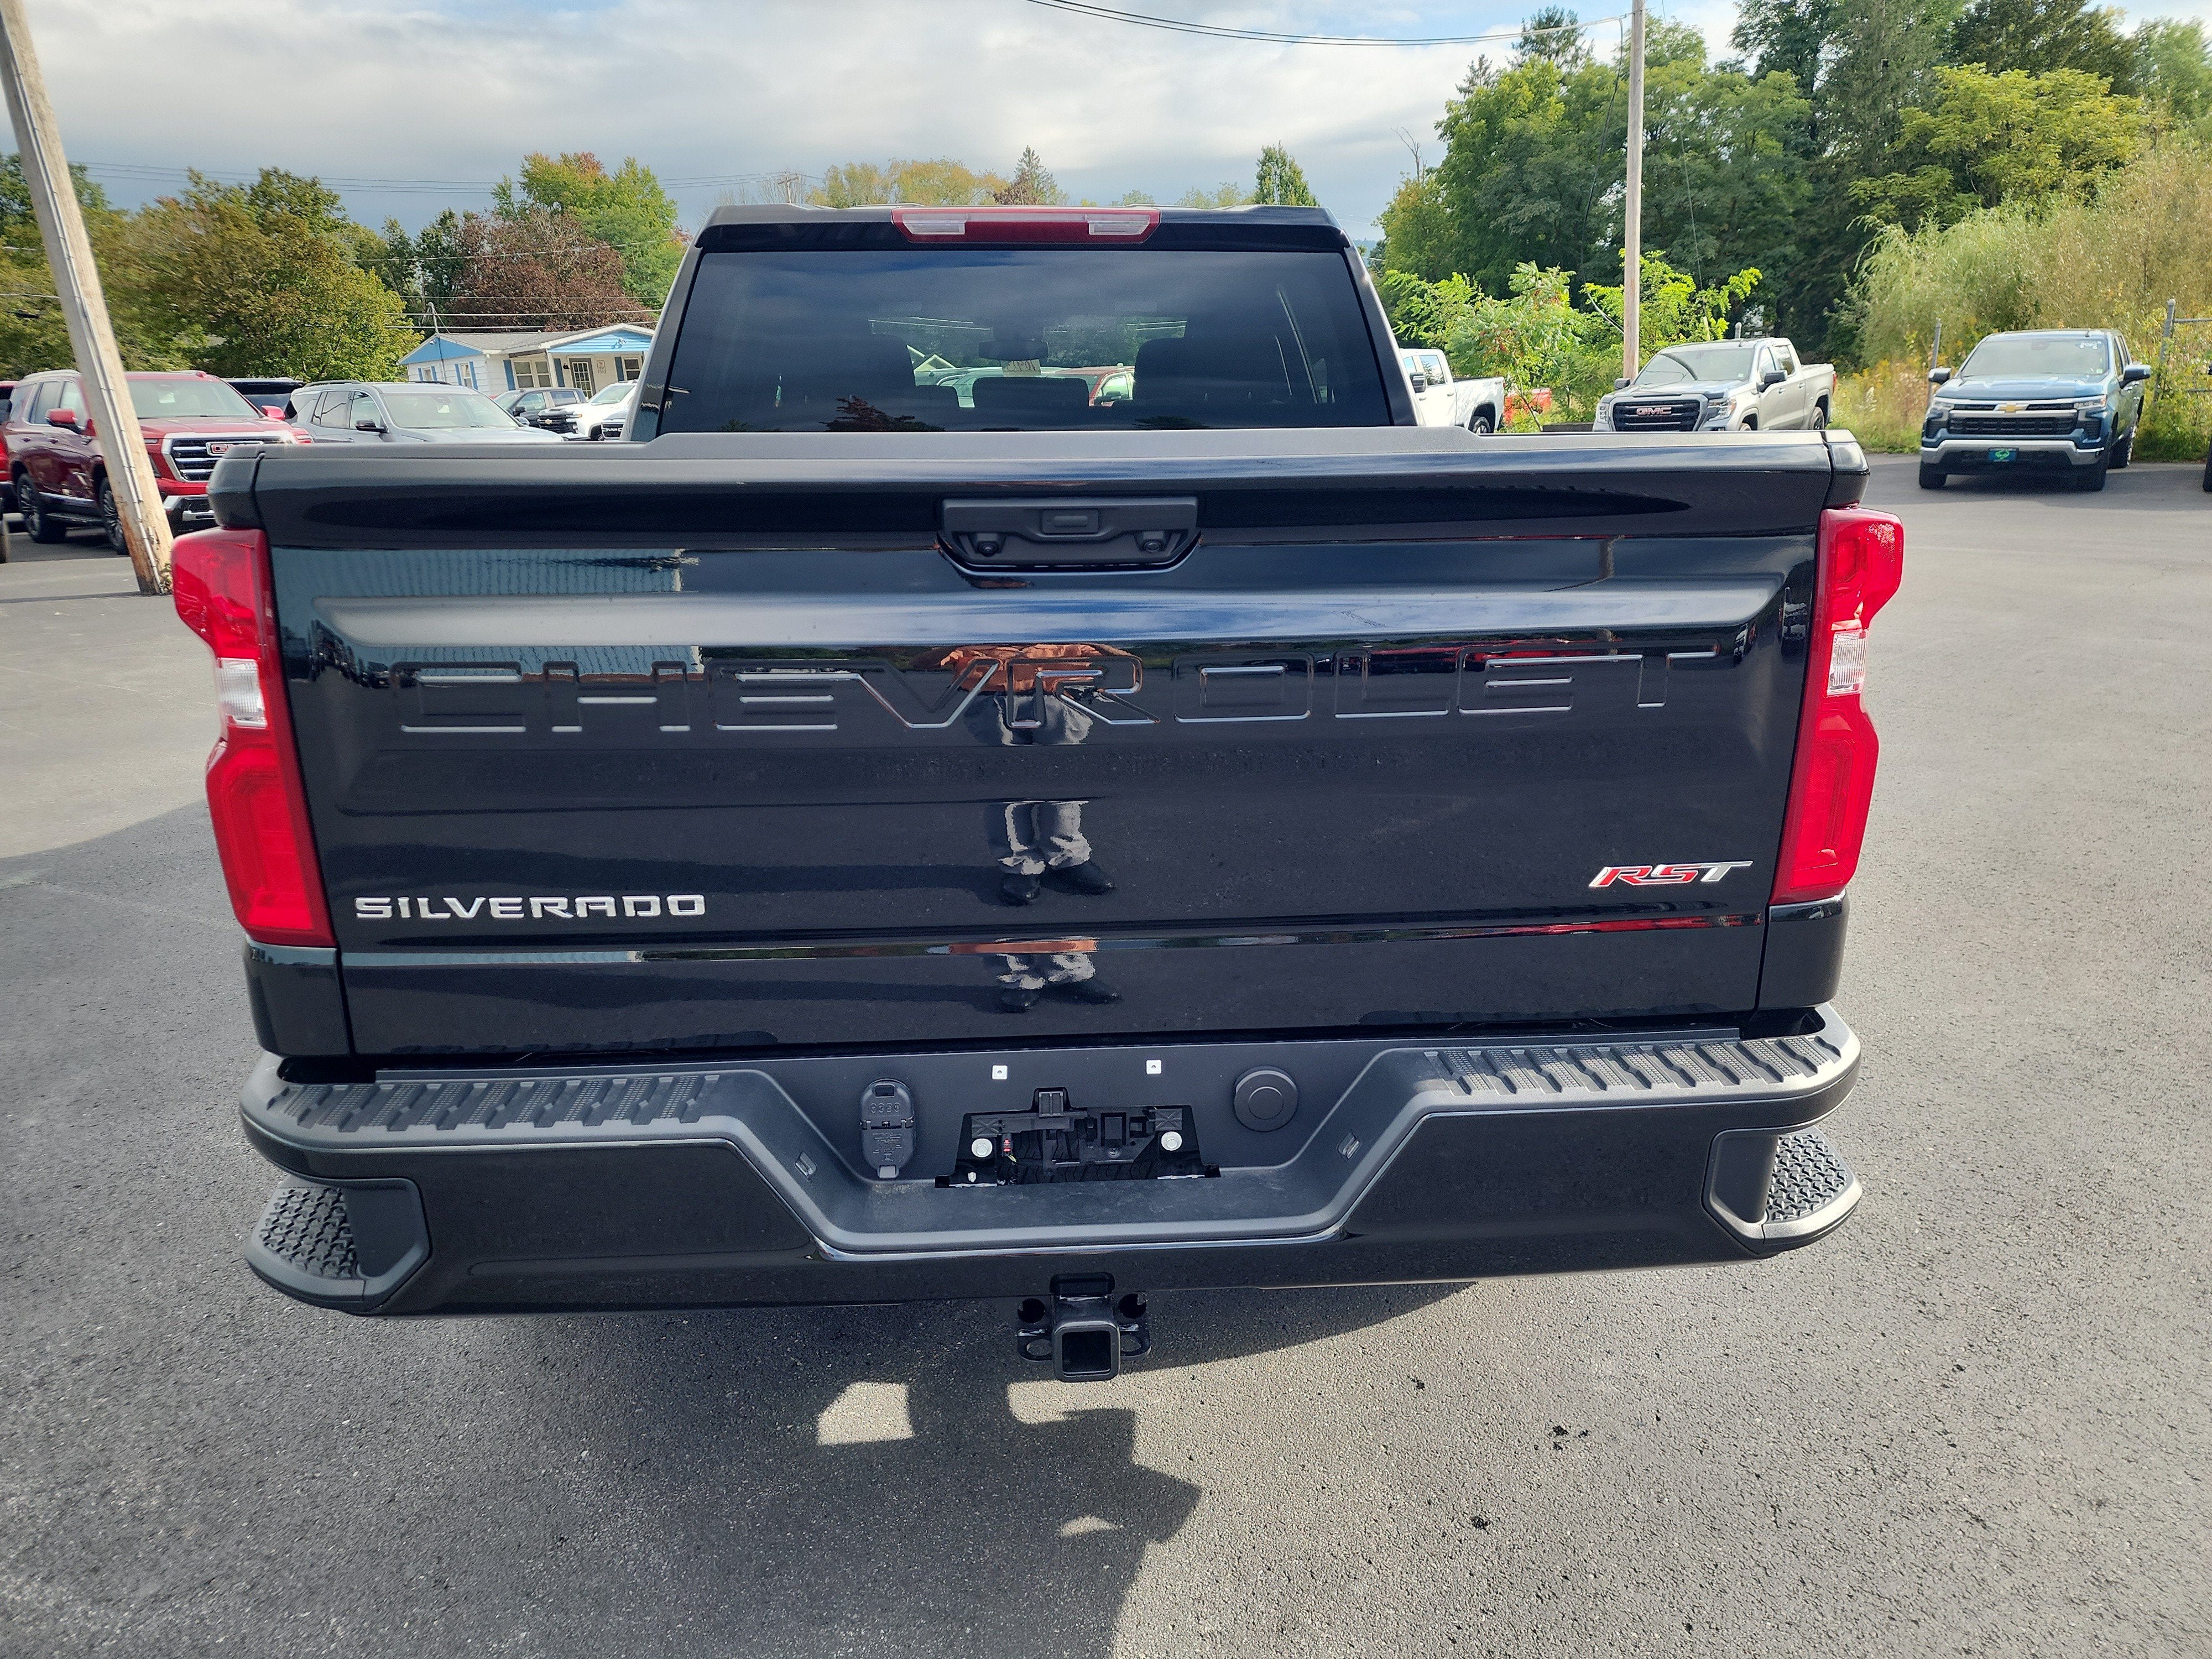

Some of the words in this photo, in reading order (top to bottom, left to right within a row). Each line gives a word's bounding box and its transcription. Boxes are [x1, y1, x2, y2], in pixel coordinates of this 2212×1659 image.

[390, 638, 1721, 733] CHEVROLET
[1589, 860, 1753, 887] RST
[354, 894, 705, 919] SILVERADO
